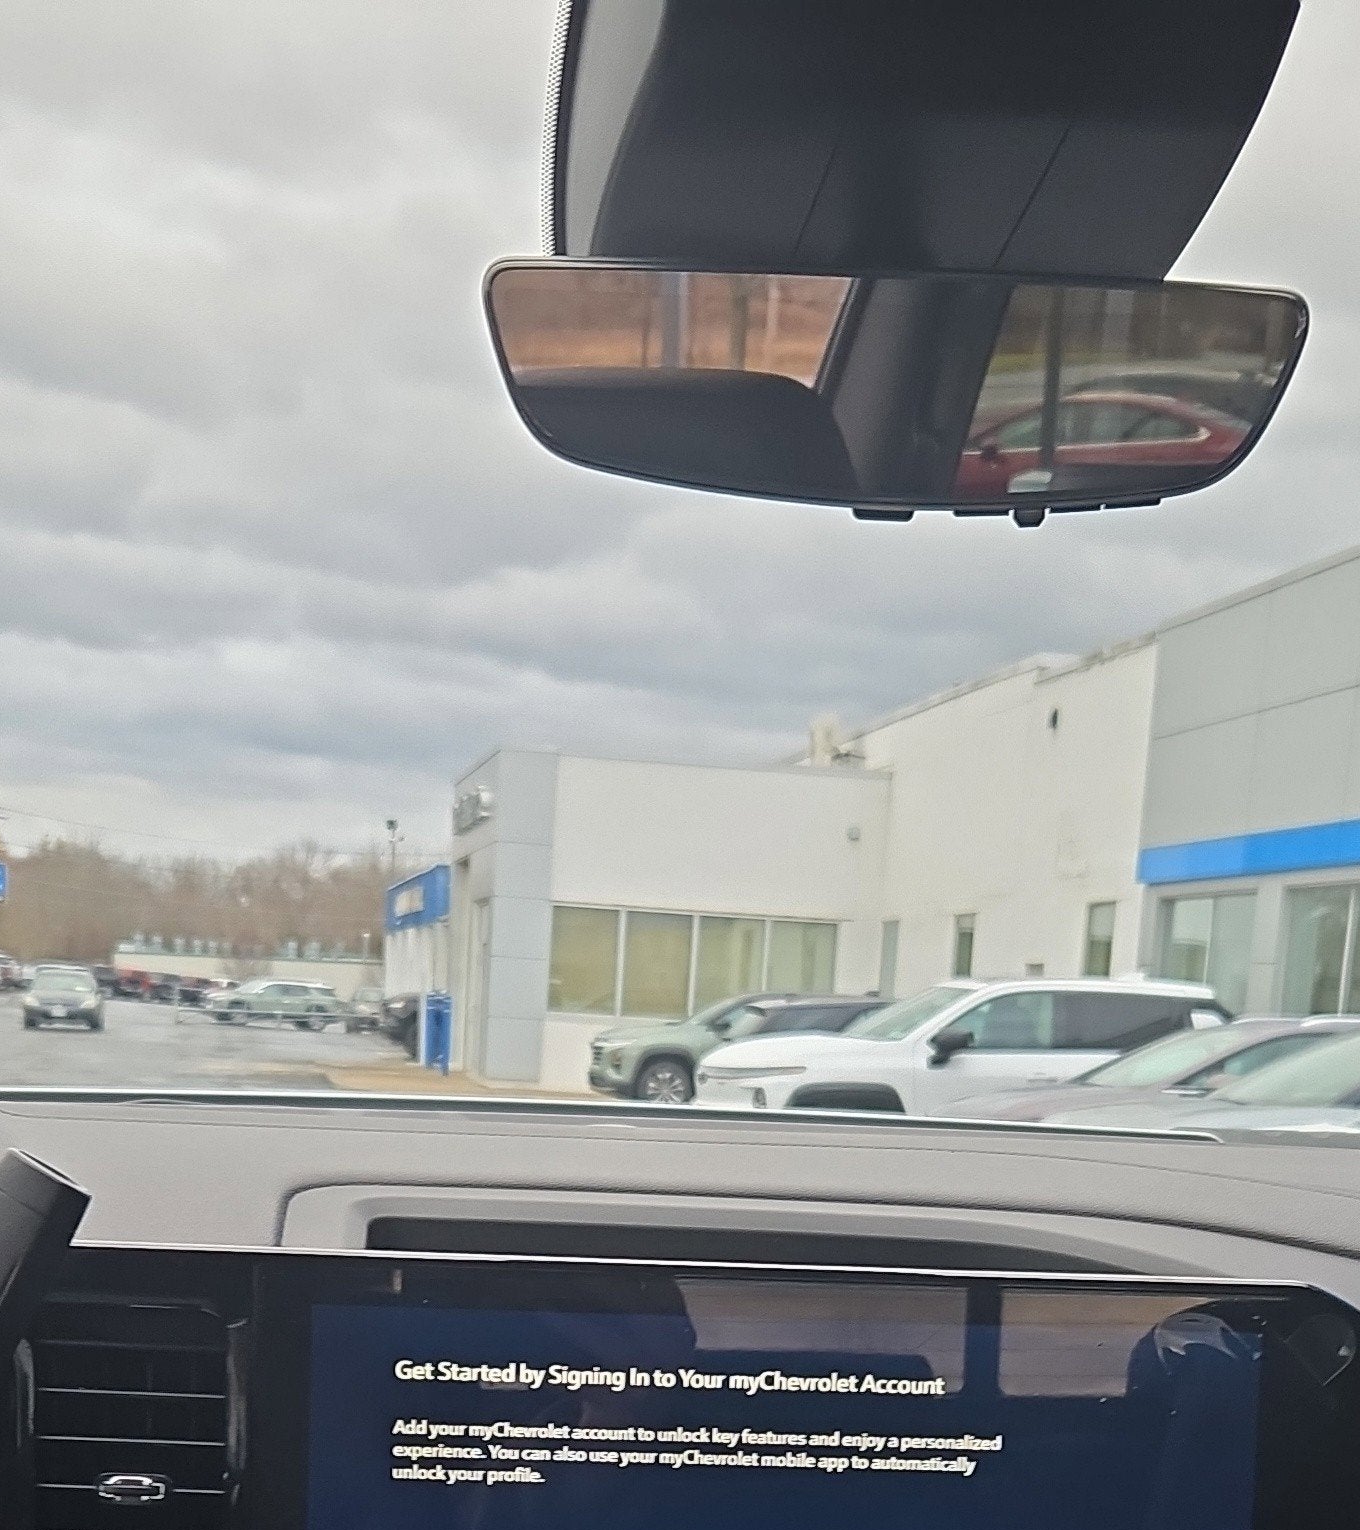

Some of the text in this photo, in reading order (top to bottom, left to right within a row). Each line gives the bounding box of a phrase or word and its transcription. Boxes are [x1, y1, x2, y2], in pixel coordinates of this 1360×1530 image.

[395, 1360, 945, 1395] Get Started by Signing In to Your myChevrolet Account
[392, 1419, 1003, 1452] Add your myChevrolet account to unlock key features and enjoy a personalized
[392, 1444, 977, 1476] experience. You can also use your myChevrolet mobile app to automatically
[392, 1465, 545, 1485] unlock your profile.
